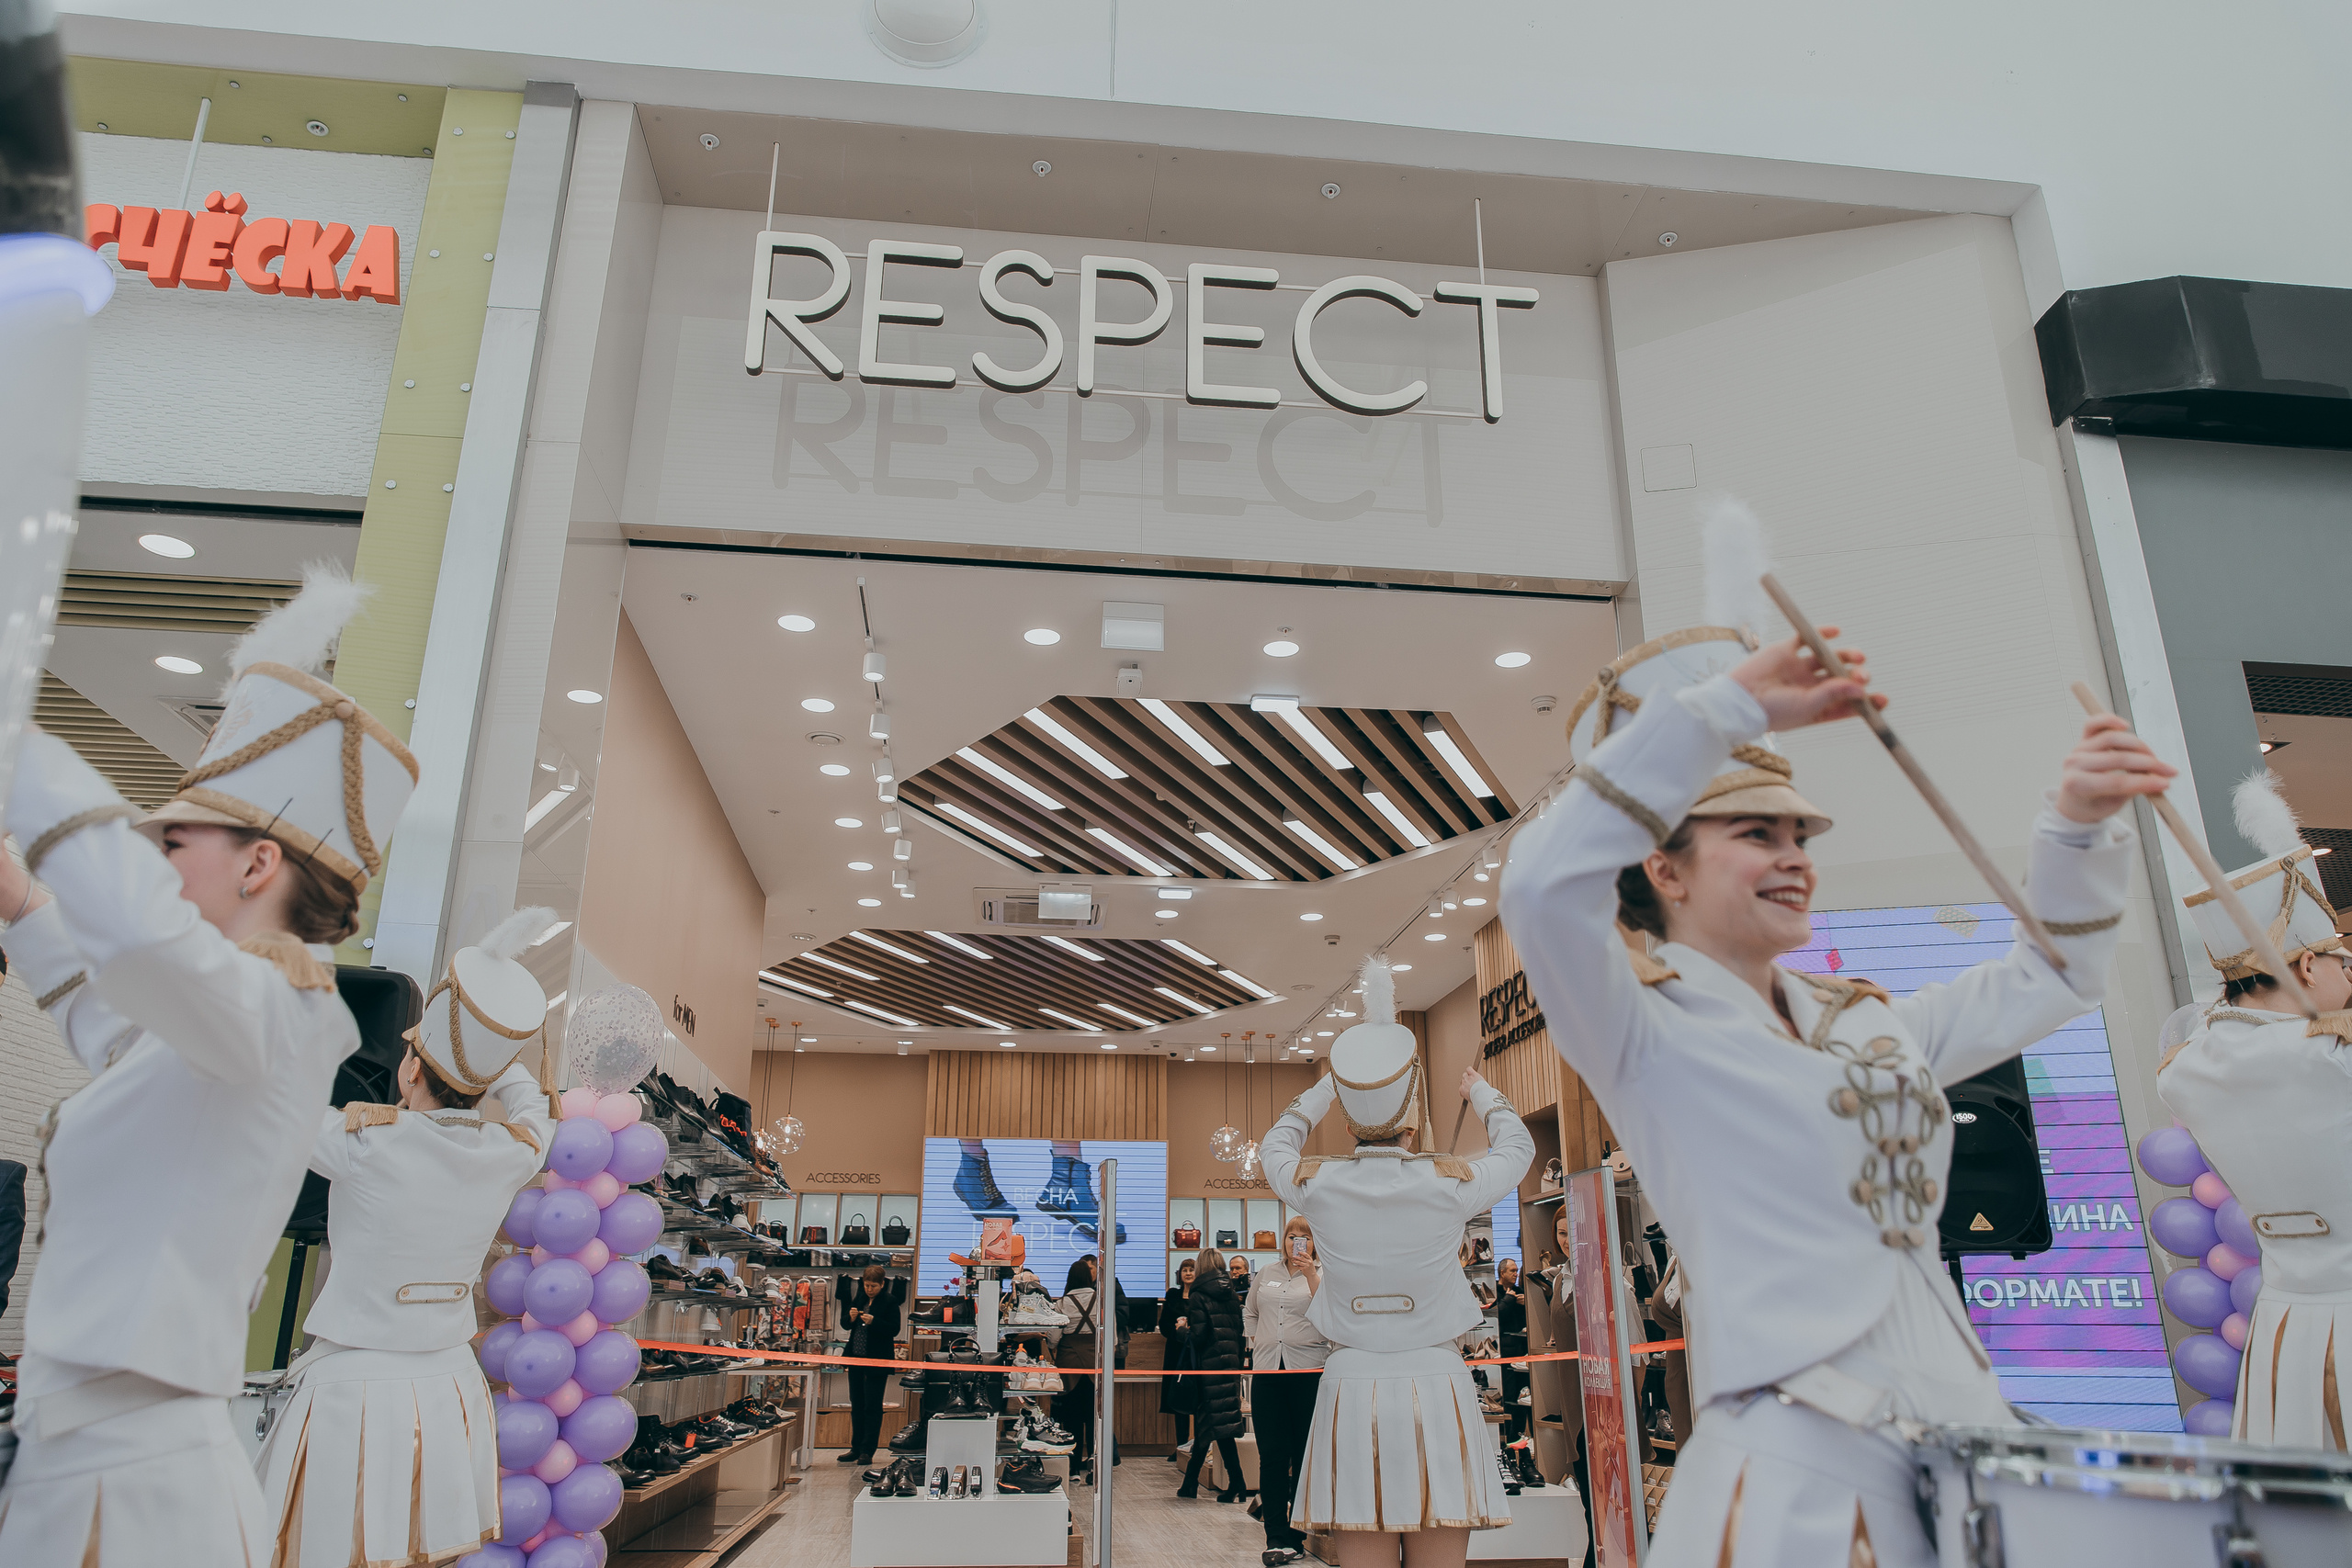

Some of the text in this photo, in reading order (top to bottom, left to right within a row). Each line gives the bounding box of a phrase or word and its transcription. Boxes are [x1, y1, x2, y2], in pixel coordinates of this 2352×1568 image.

[744, 231, 1540, 423] RESPECT
[1479, 970, 1537, 1037] RESPEC
[673, 994, 696, 1038] for MEN
[806, 1172, 881, 1184] ACCESSORIES
[1204, 1179, 1272, 1190] ACCESSORIE
[1013, 1187, 1080, 1205] ВЕСНА
[2050, 1203, 2134, 1231] ИНА
[1582, 1356, 1611, 1375] НОВАЯ
